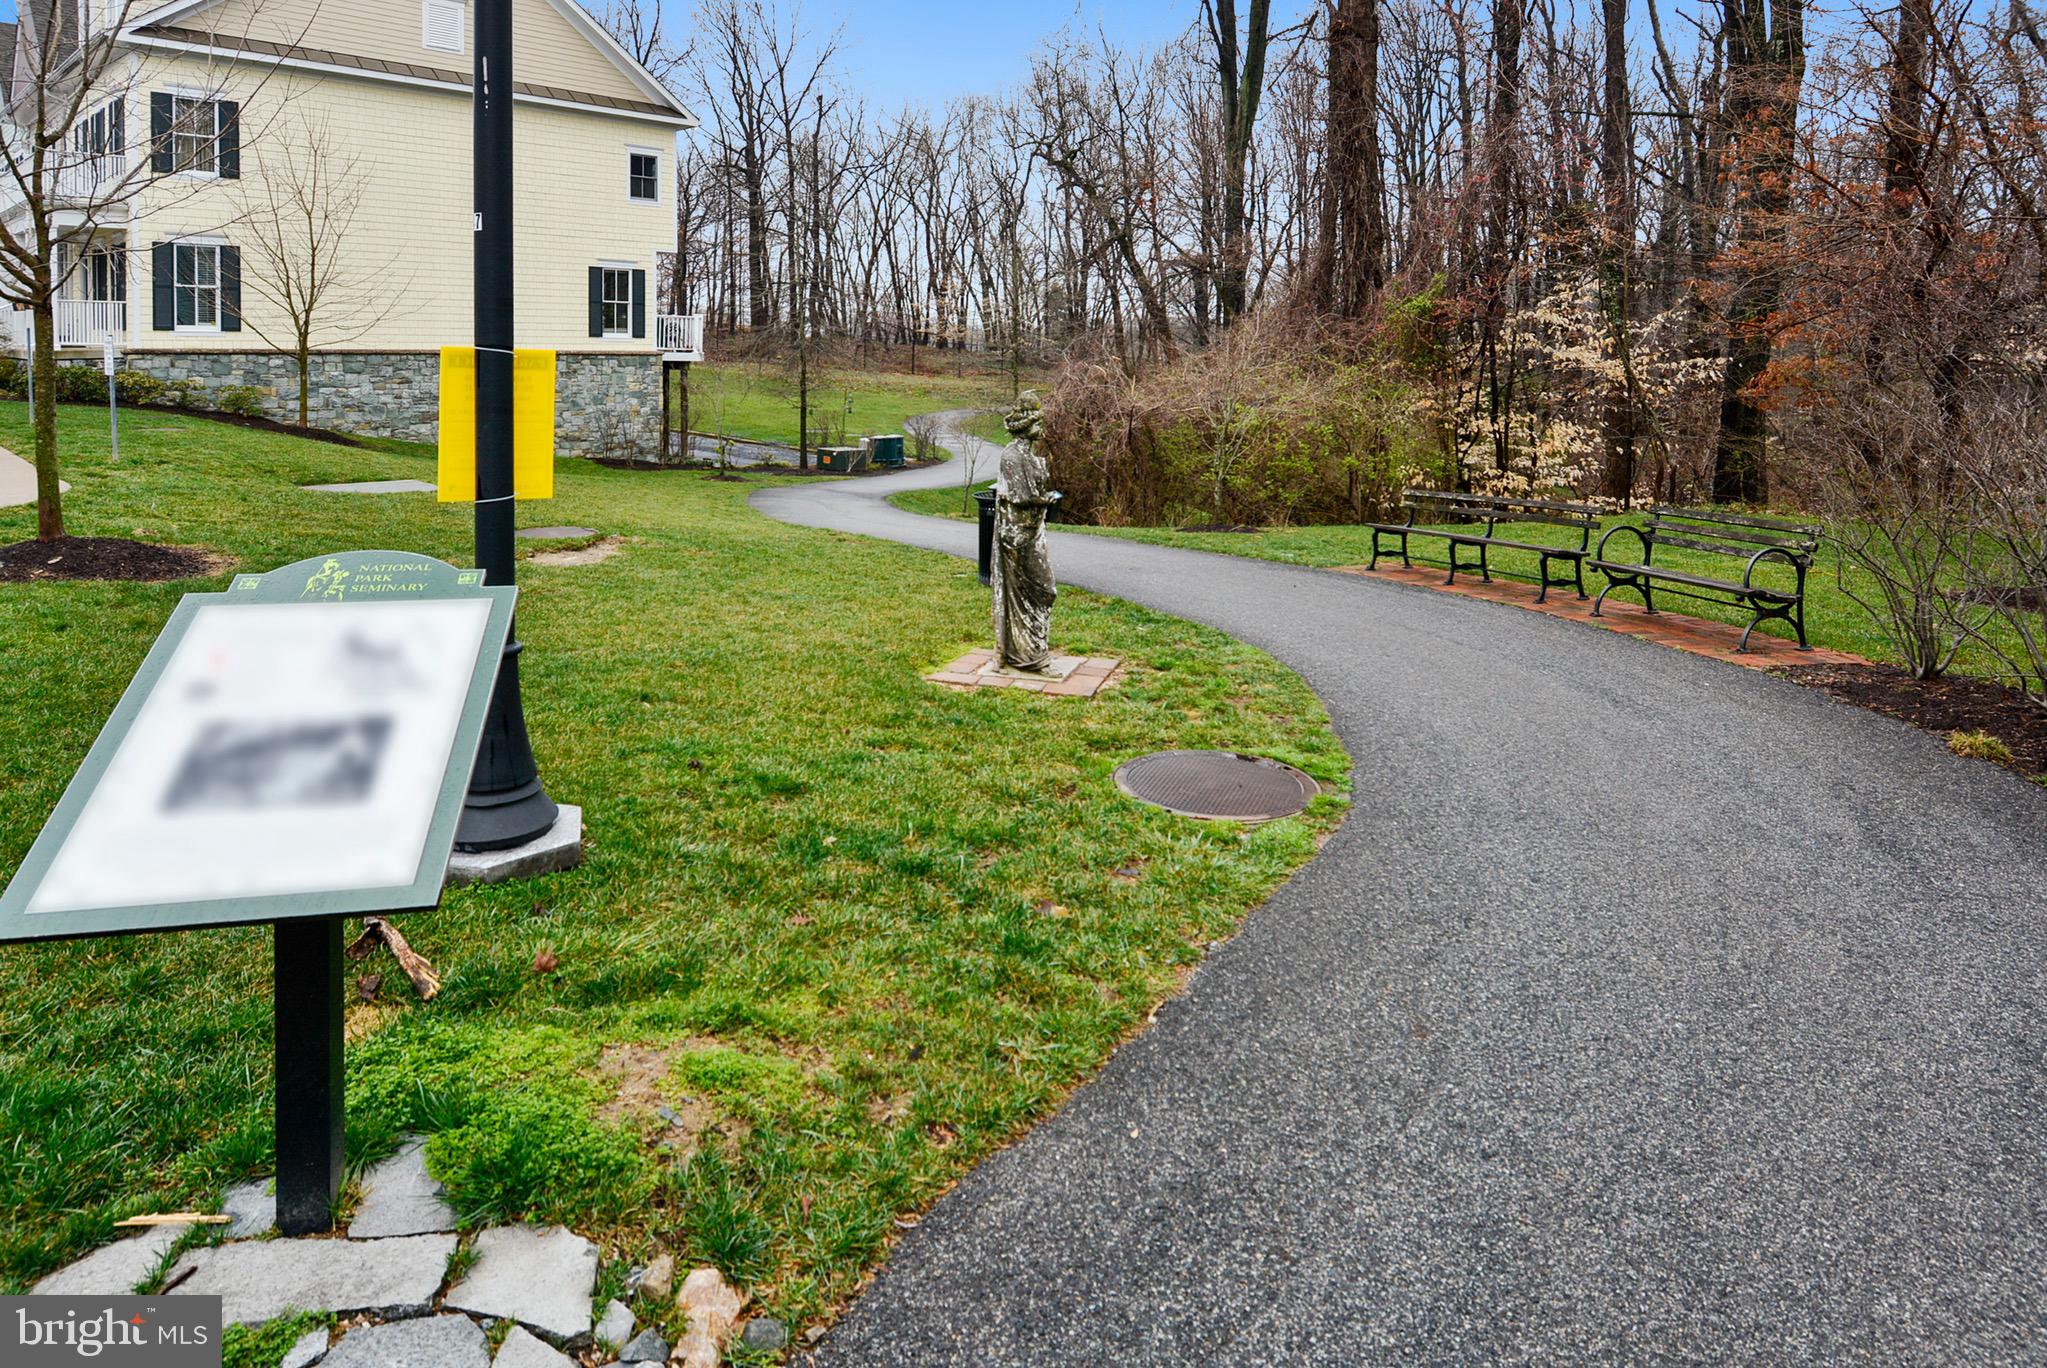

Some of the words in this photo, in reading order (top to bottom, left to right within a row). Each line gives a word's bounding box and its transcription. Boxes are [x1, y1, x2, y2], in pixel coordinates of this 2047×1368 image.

[360, 564, 432, 572] NATIONAL
[355, 574, 392, 582] PARK
[351, 583, 427, 592] SEMINARY
